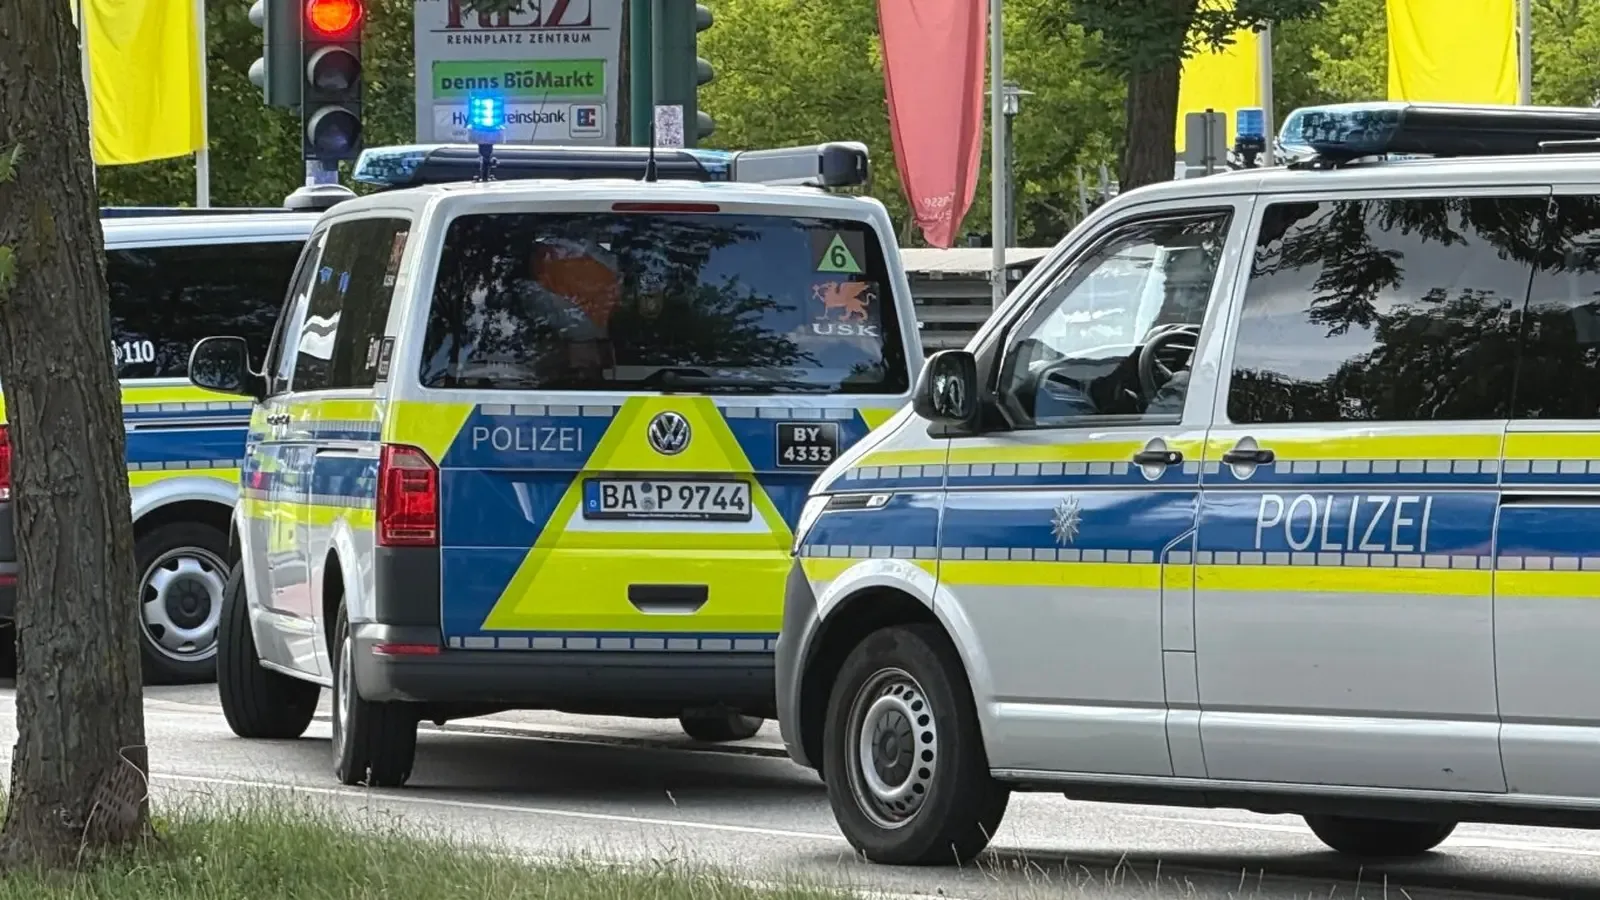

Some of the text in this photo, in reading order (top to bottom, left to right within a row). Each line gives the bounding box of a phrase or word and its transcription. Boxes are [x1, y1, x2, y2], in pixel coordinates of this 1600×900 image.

[447, 33, 592, 45] RENNPLATZ ZENTRUM
[452, 109, 566, 128] Hyreinsbank
[830, 245, 847, 269] 6
[811, 322, 879, 338] USK
[122, 339, 155, 364] 110
[471, 426, 583, 453] POLIZEI
[793, 427, 821, 442] BY
[783, 445, 833, 462] 4333
[602, 484, 746, 511] BA P 9744
[1254, 493, 1434, 553] POLIZEI
